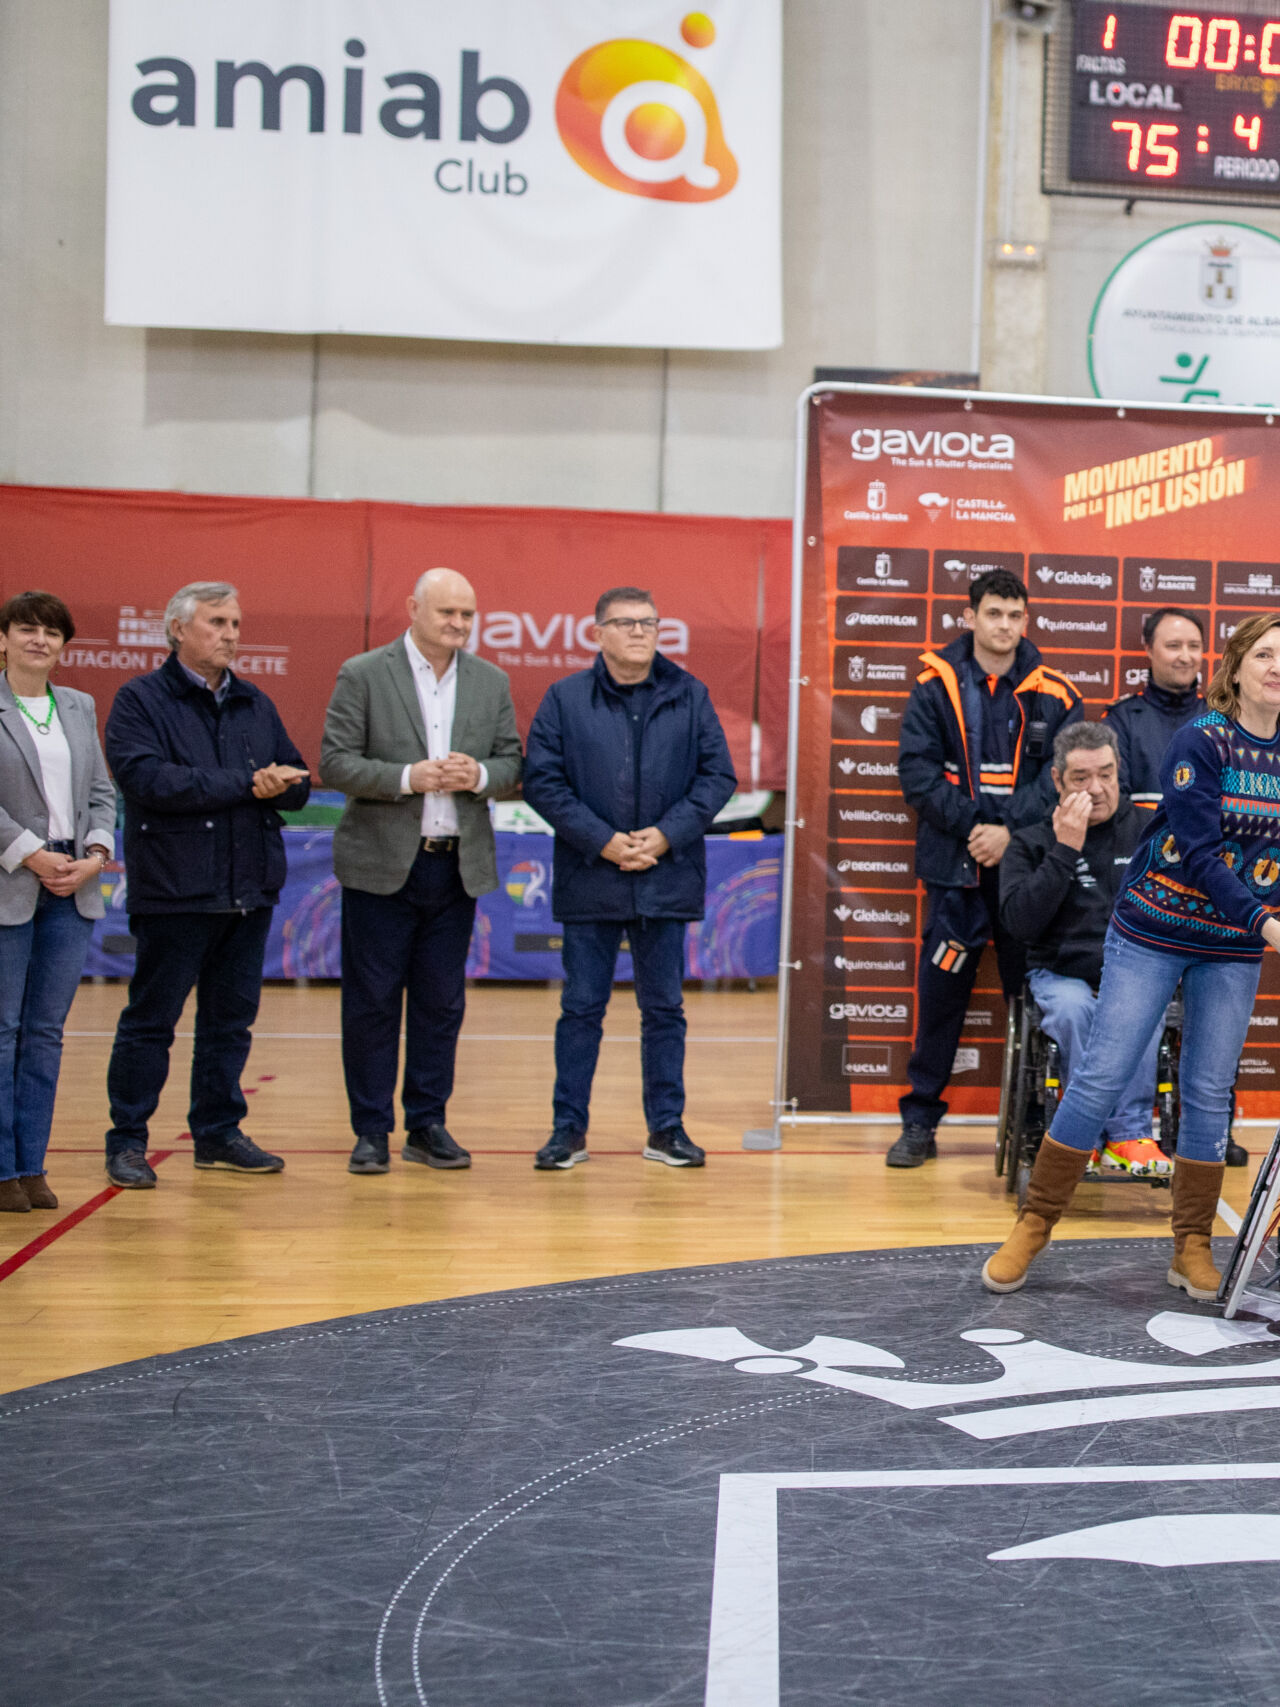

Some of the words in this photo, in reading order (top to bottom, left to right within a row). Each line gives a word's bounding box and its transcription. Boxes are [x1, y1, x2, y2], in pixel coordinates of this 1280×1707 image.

[1102, 14, 1118, 50] 1
[131, 38, 531, 145] amiab
[1089, 79, 1182, 111] LOCAL
[1111, 120, 1179, 177] 75
[1233, 114, 1261, 151] 4
[434, 159, 529, 196] Club
[1214, 155, 1280, 182] PERIODO
[851, 428, 1015, 461] gaviota
[1064, 437, 1213, 504] MOVIMIENTO
[1063, 502, 1087, 522] POR
[1088, 498, 1104, 516] LA
[1105, 457, 1245, 529] INCLUSIÓN
[955, 511, 969, 520] LA
[971, 512, 1016, 522] MANCHA
[1055, 571, 1112, 589] Globalcaja
[860, 614, 917, 626] DECATHLON
[851, 861, 909, 872] DECATHLON
[852, 908, 910, 925] Globalcaja
[830, 1003, 907, 1020] gaviota
[852, 1063, 888, 1073] UCLM
